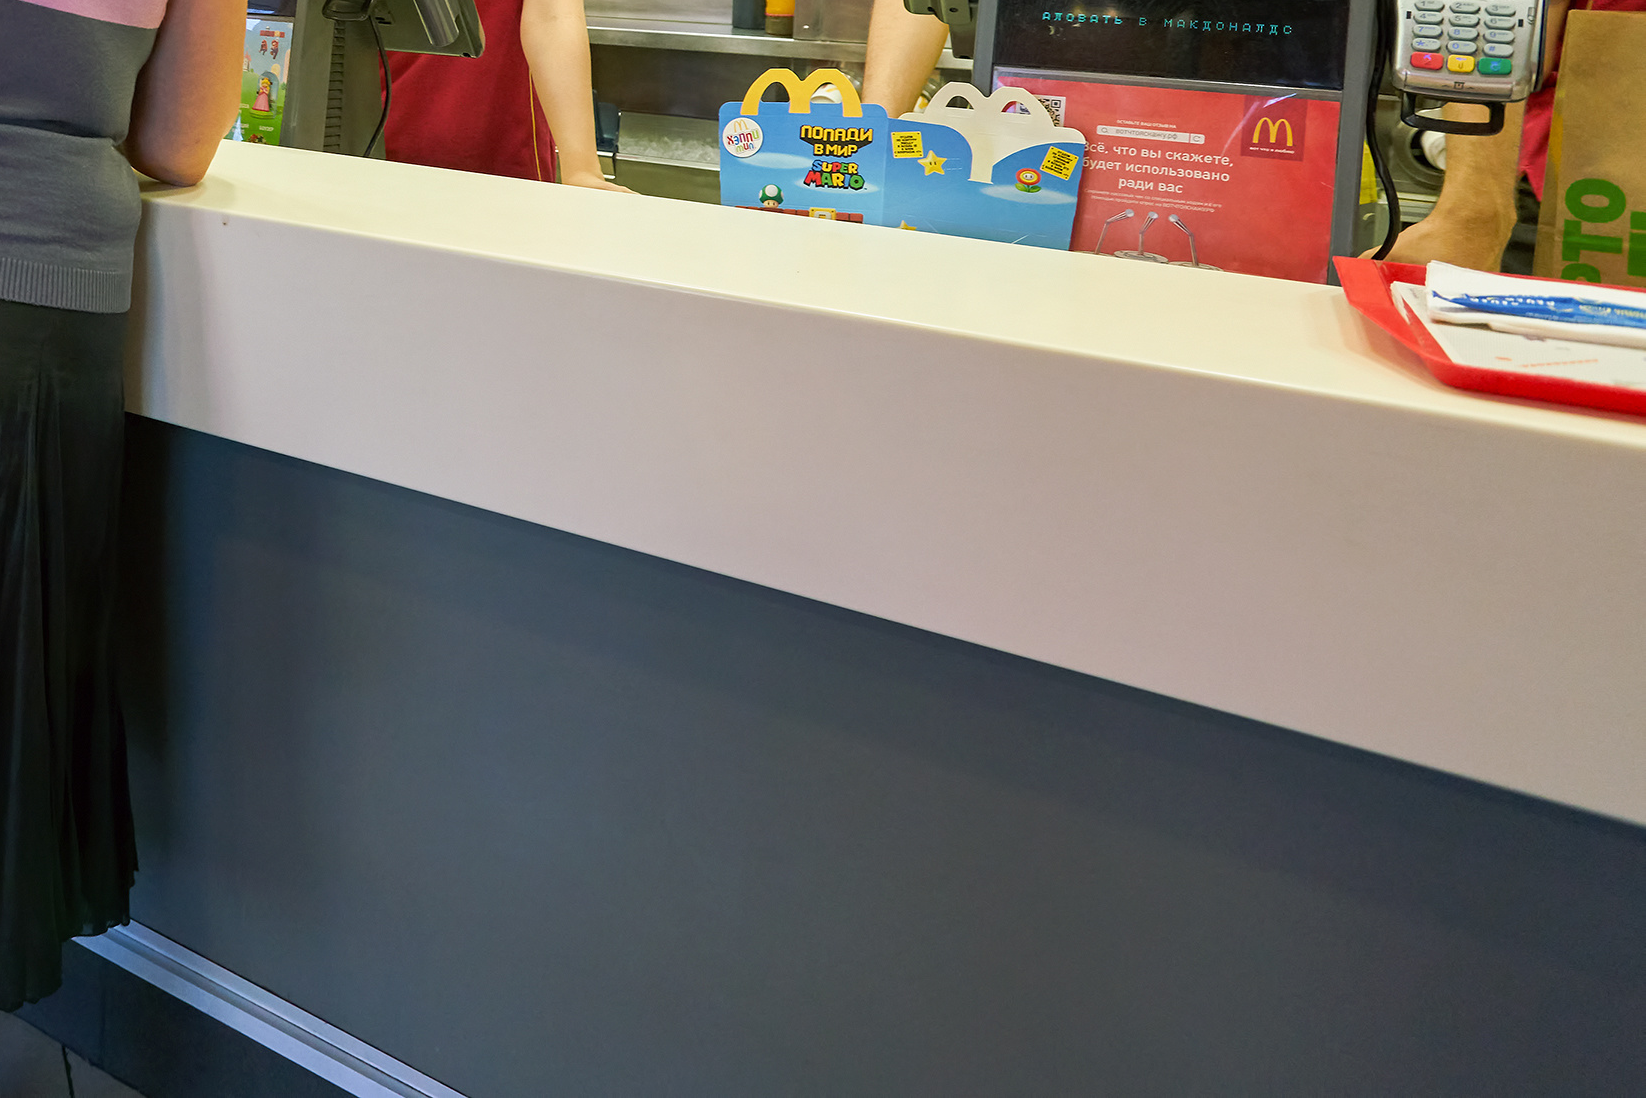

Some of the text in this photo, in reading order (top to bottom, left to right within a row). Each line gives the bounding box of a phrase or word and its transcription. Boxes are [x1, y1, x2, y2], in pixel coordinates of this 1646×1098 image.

[1041, 11, 1293, 36] АЛОВАТЬ В МАКДОНАЛДС
[800, 125, 874, 142] ПОПАДИ
[814, 143, 858, 157] В МИР
[1113, 145, 1137, 156] что
[1141, 149, 1161, 159] вы
[1165, 151, 1234, 168] скажете,
[812, 159, 859, 174] SUPER
[1082, 157, 1121, 172] будет
[1125, 163, 1230, 182] использовано
[803, 170, 867, 191] MARIO
[1118, 178, 1183, 194] ради вас
